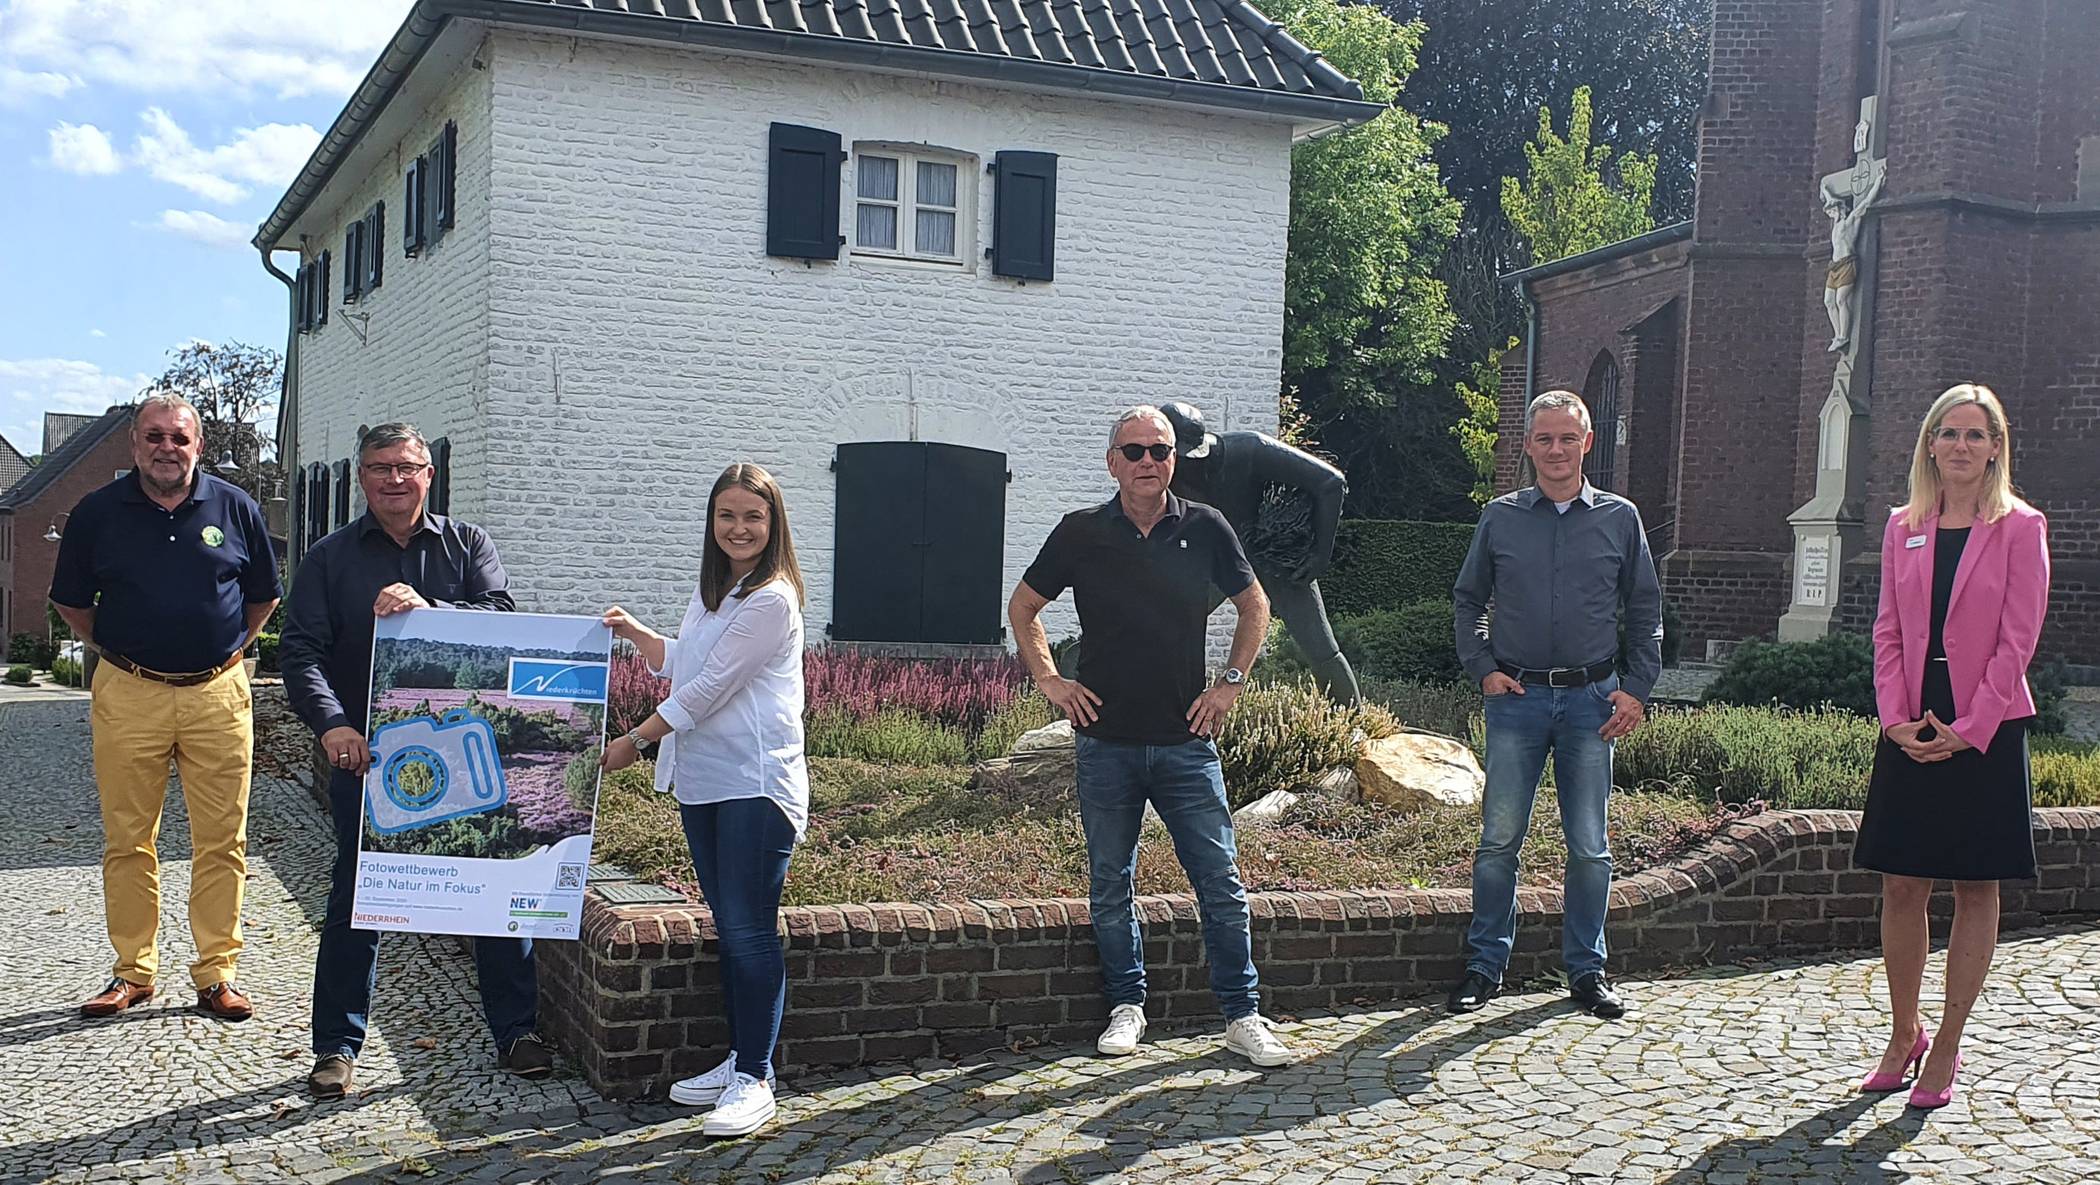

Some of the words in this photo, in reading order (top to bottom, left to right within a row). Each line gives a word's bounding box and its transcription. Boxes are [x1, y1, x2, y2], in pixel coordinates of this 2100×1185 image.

[360, 860, 459, 877] Fotowettbewerb
[387, 878, 423, 891] Natur
[425, 880, 440, 892] im
[510, 897, 539, 909] NEW
[354, 912, 410, 924] NIEDERRHEIN
